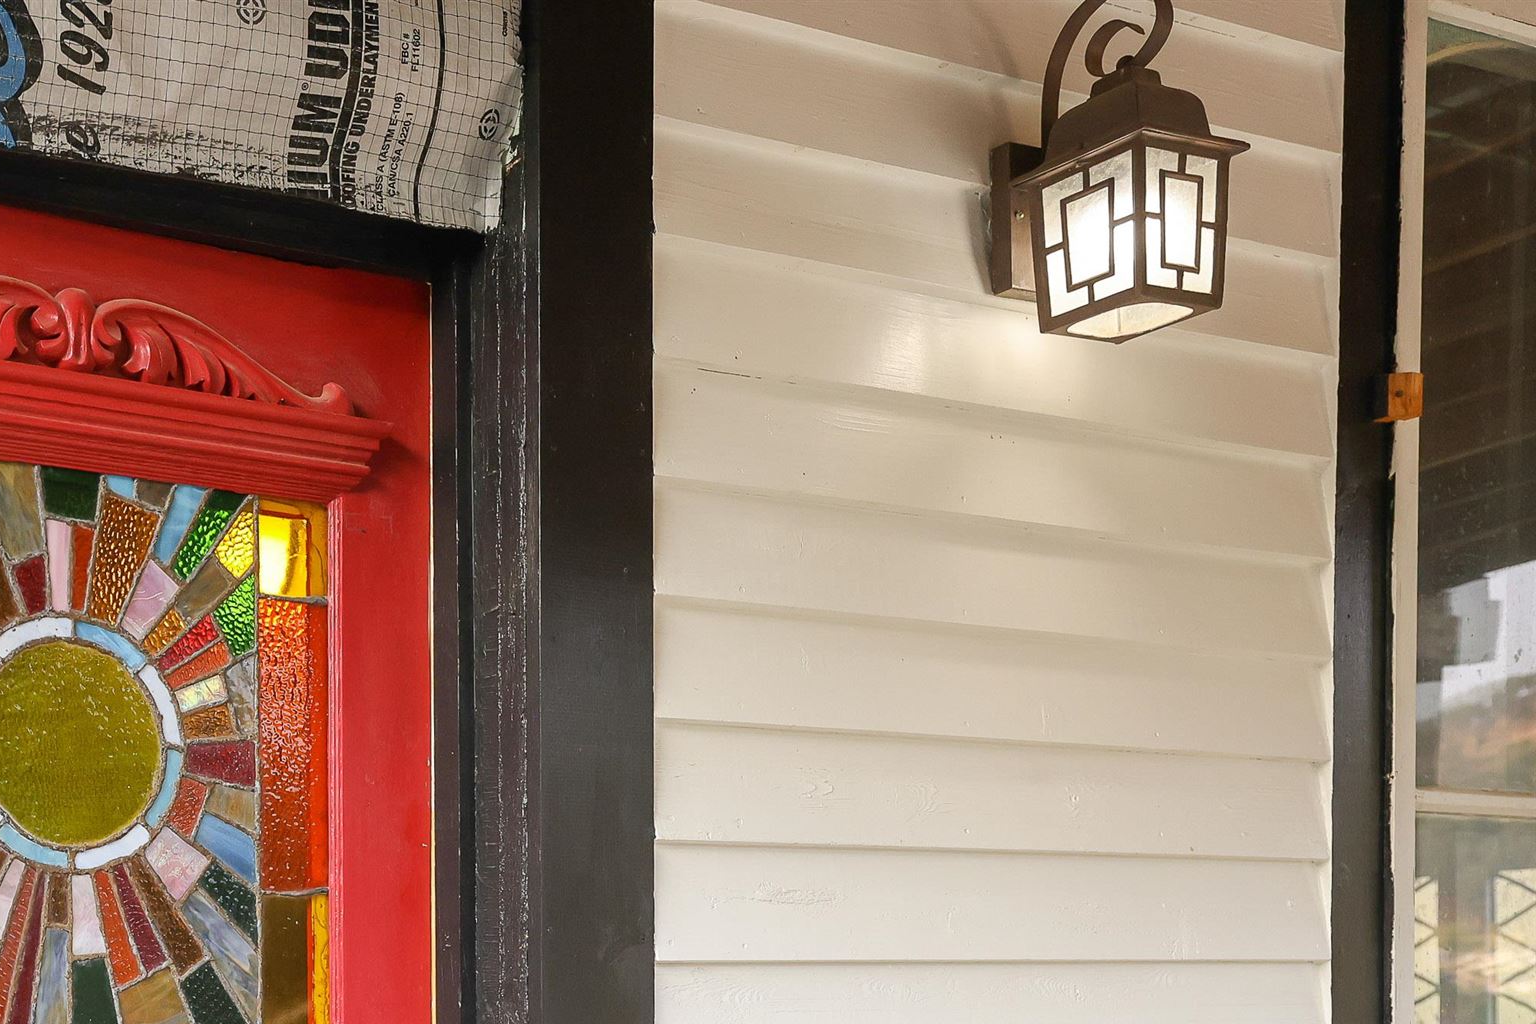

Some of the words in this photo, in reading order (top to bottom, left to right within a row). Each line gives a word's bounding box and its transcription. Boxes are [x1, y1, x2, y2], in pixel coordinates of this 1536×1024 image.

[56, 0, 114, 95] 192
[348, 0, 380, 137] UNDERLAYMEN
[401, 41, 410, 65] FBC
[410, 28, 421, 72] FL11602
[339, 140, 361, 209] OOFING
[374, 175, 386, 212] CLASS
[380, 126, 396, 164] (ASTM
[391, 92, 406, 126] E-108)
[387, 147, 403, 198] CAN/CSA
[399, 111, 414, 147] A220.1
